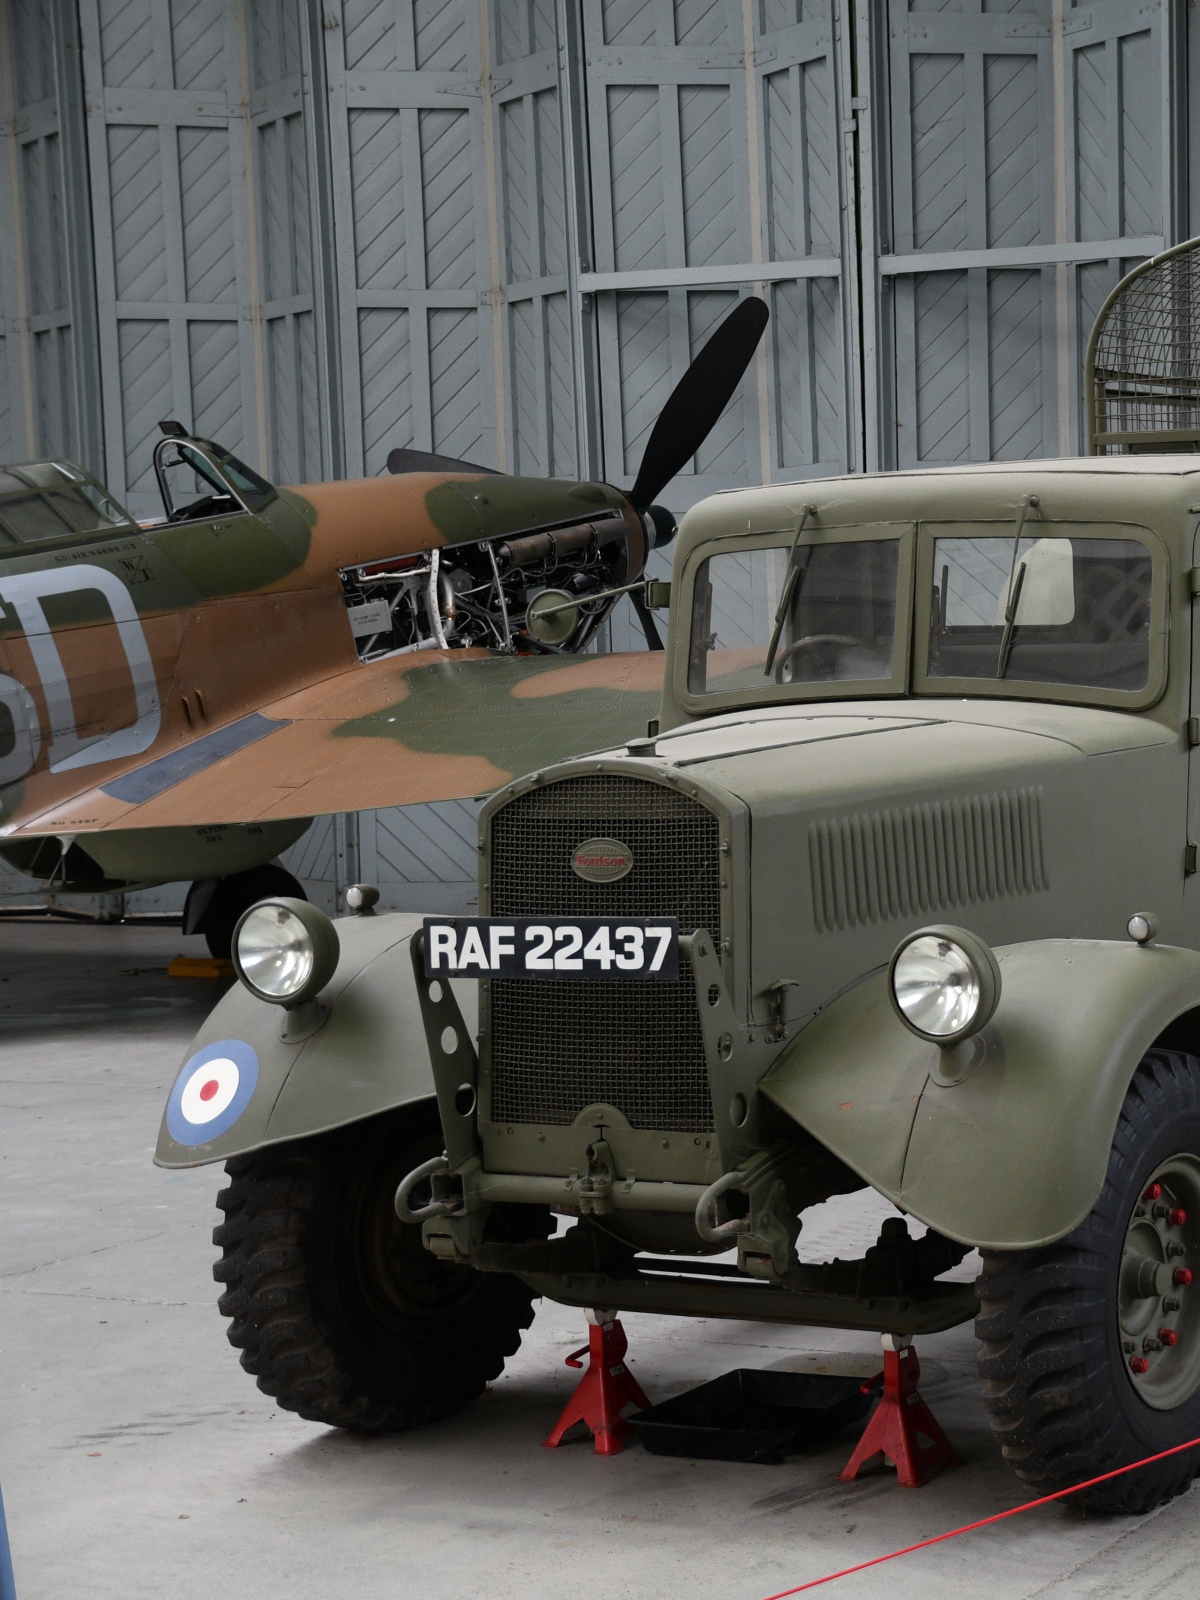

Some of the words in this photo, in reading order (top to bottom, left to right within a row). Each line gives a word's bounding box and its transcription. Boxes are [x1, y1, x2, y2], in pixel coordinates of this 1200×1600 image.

[197, 824, 229, 835] GLYCOL
[576, 854, 628, 867] Fordson
[429, 925, 515, 970] RAF
[525, 925, 672, 971] 22437
